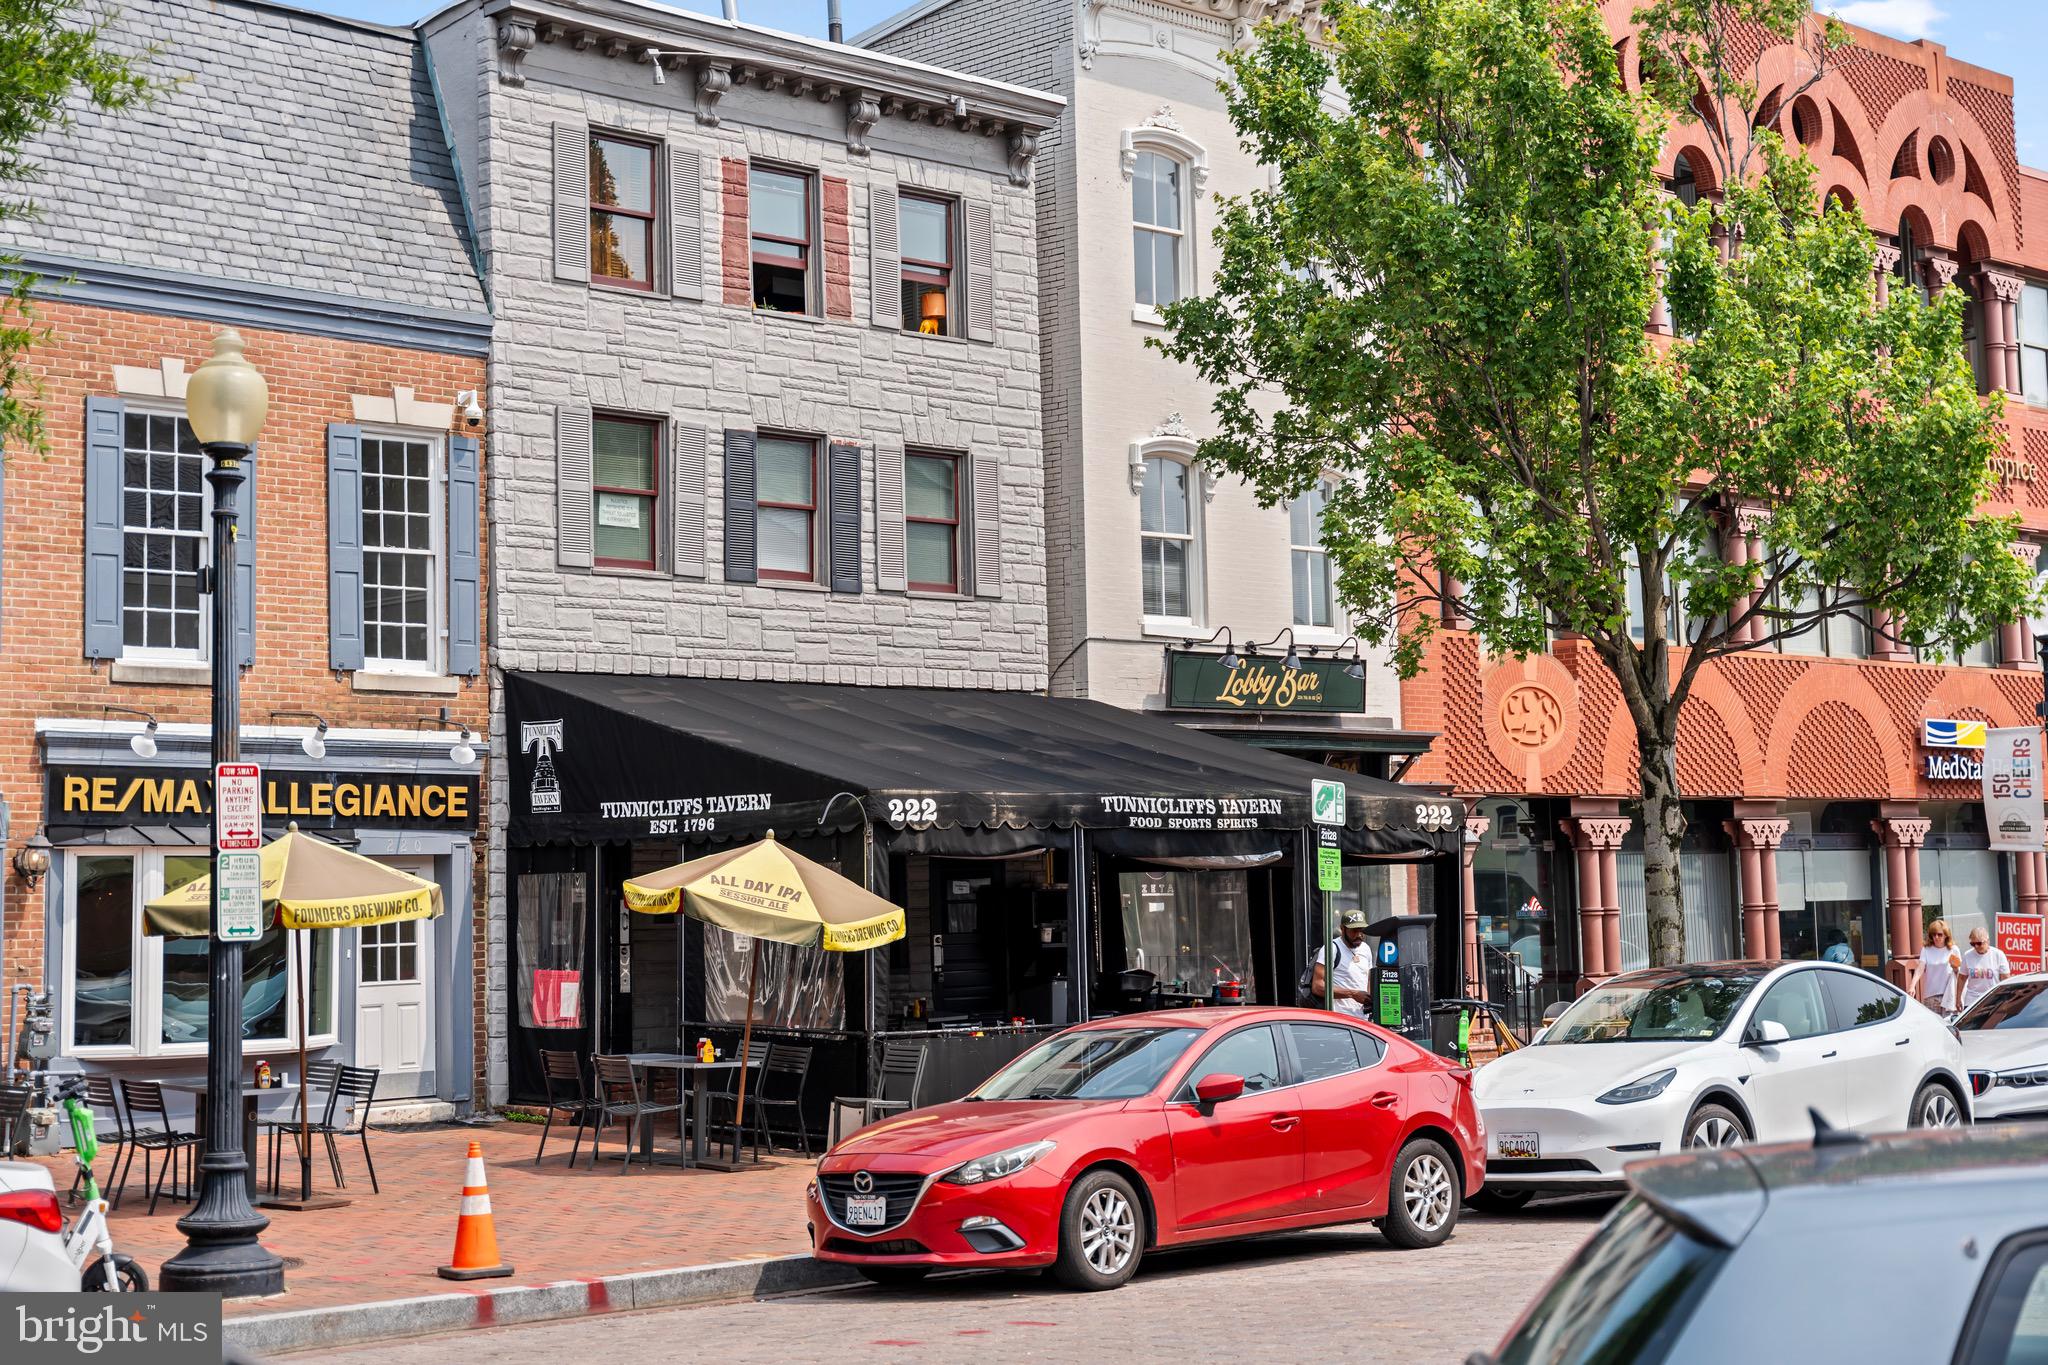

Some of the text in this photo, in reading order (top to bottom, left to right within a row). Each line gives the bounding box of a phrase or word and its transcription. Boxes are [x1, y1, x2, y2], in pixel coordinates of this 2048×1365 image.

[1986, 451, 2038, 489] ospice
[1216, 659, 1320, 707] Lobby Bar
[524, 725, 561, 742] TUNNICLIFFS
[223, 767, 254, 775] TOW AWAY
[1928, 754, 1983, 779] MedSta
[2013, 738, 2032, 799] CHEERS
[231, 778, 242, 786] NO
[1992, 774, 2011, 799] 150
[222, 787, 254, 795] PARKING
[534, 794, 558, 805] TAVERN
[600, 793, 772, 818] TUNNICLIFFS TAVERN
[888, 798, 937, 822] 222
[1101, 796, 1282, 815] TUNNICLIFFS TAVERN
[1129, 817, 1258, 829] FOOD SPORTS SPIRITS
[1415, 804, 1453, 825] 222
[650, 818, 715, 834] EST. 1796
[387, 839, 421, 852] 220
[221, 857, 229, 868] 2
[186, 882, 212, 893] AL
[710, 874, 803, 903] ALL DAY IPA
[1141, 884, 1174, 893] ZETA
[719, 889, 789, 912] SESSION ALE
[294, 897, 423, 924] FOUNDERS BREWING CO.
[854, 922, 888, 942] BREWING
[1998, 922, 2041, 936] URGENT
[1384, 942, 1396, 963] P
[2005, 938, 2033, 951] CARE
[2030, 963, 2041, 972] DE
[848, 1206, 883, 1221] 9BEN417
